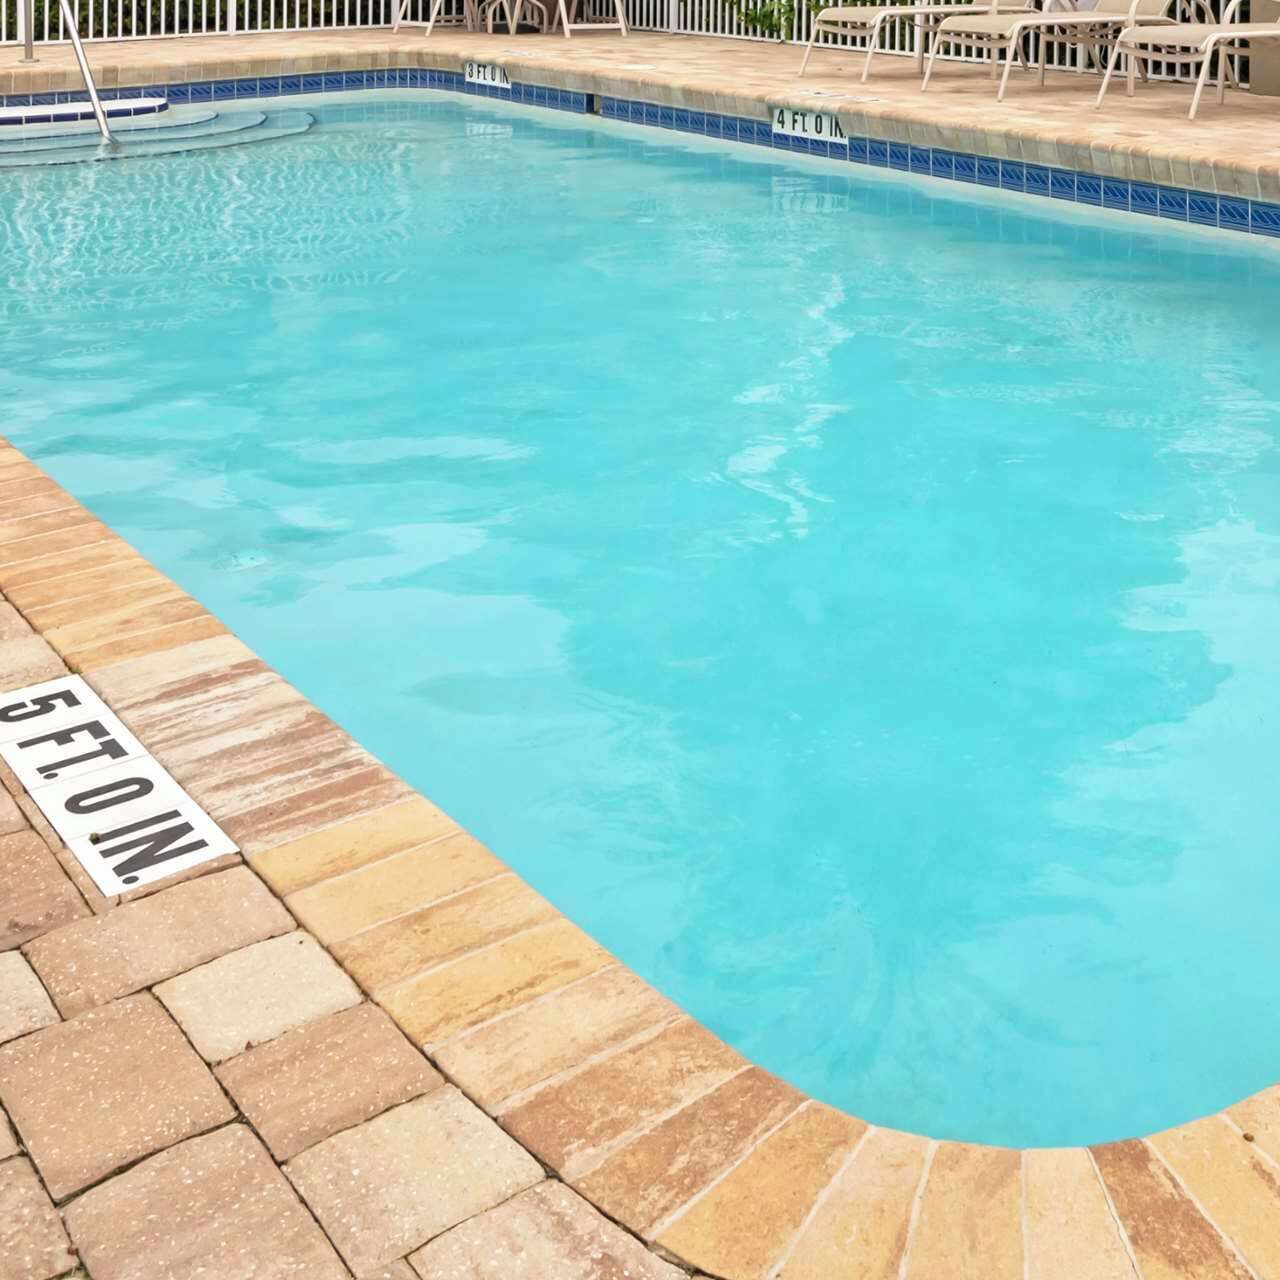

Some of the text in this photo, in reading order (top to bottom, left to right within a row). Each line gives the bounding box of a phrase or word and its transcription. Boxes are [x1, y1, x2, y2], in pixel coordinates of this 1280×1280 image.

[777, 108, 785, 129] 4
[792, 111, 808, 133] FT.
[815, 114, 823, 134] 0
[16, 719, 129, 780] FT.
[64, 776, 154, 815] 0
[89, 809, 209, 885] IN.
